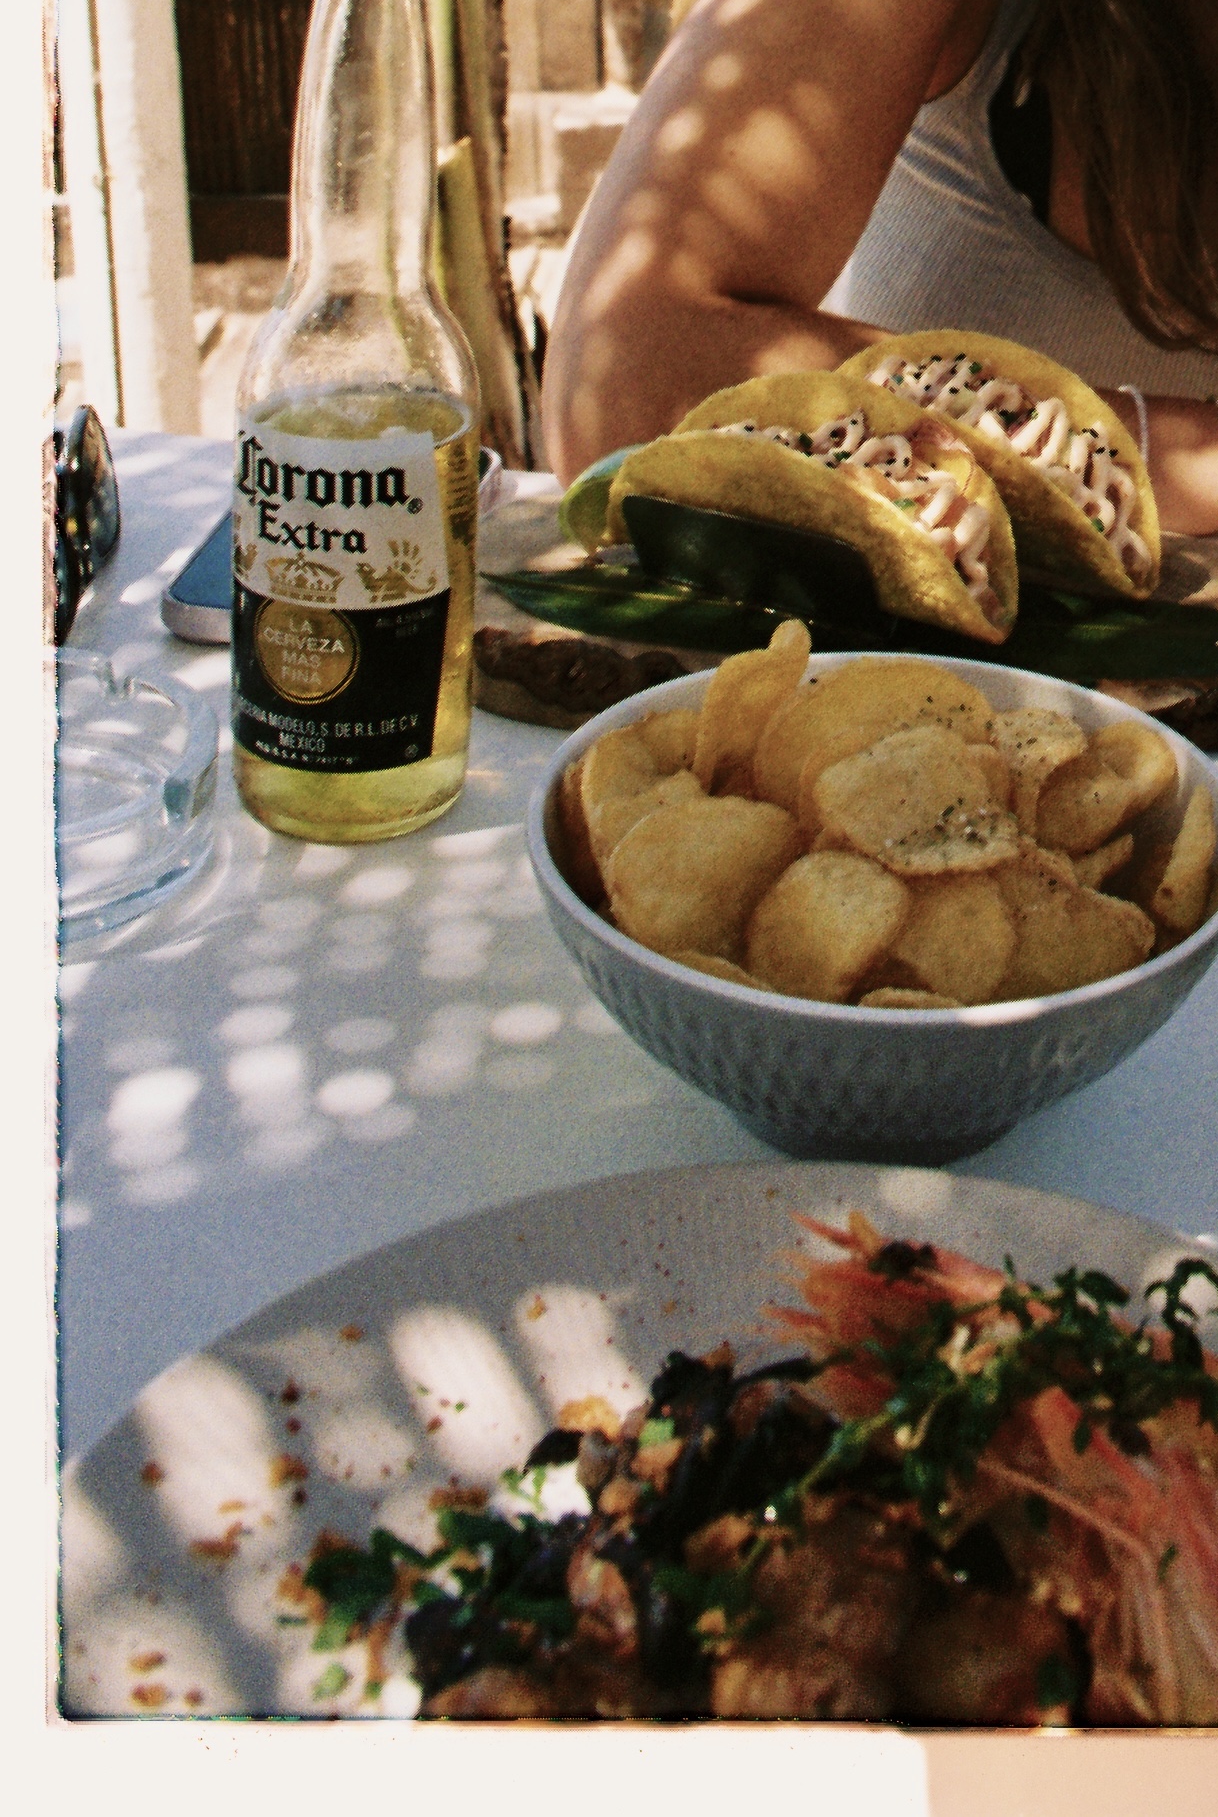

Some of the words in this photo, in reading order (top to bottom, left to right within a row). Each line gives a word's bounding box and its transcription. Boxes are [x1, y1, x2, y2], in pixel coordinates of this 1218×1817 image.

[237, 430, 410, 510] Corona
[259, 499, 368, 554] Extra
[289, 618, 313, 634] LA
[263, 626, 345, 653] CERVEZA
[281, 666, 322, 685] FINA
[334, 722, 352, 738] DE
